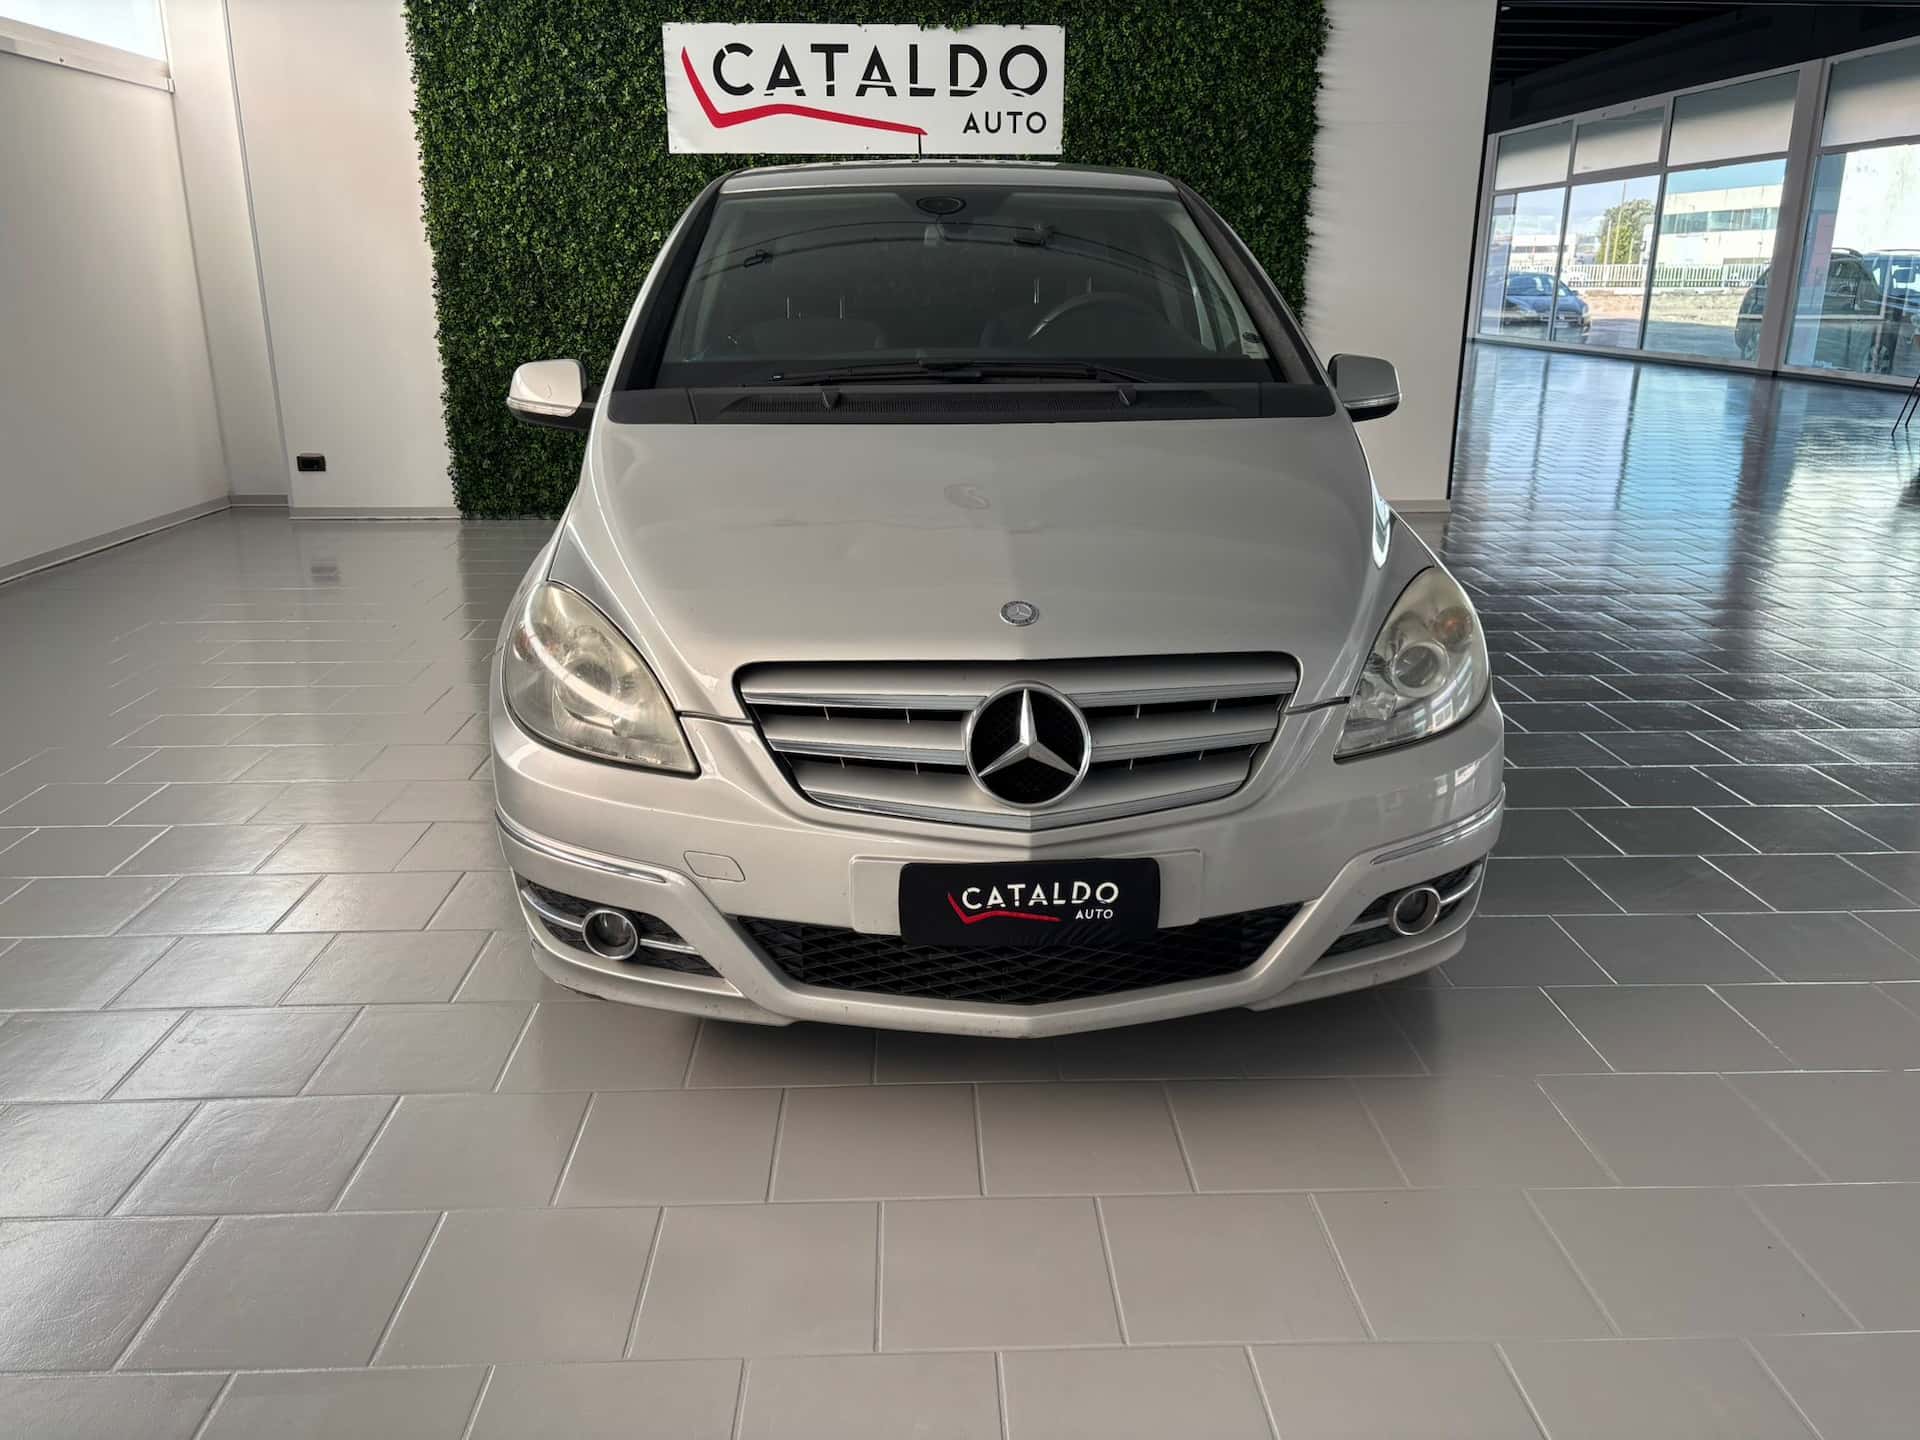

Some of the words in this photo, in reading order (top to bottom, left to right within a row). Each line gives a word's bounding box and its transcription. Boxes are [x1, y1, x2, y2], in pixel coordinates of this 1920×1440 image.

[712, 42, 1048, 98] CATALDO
[962, 111, 1047, 134] AUTO
[961, 881, 1119, 910] CATALDO
[1075, 908, 1113, 920] AUTO
